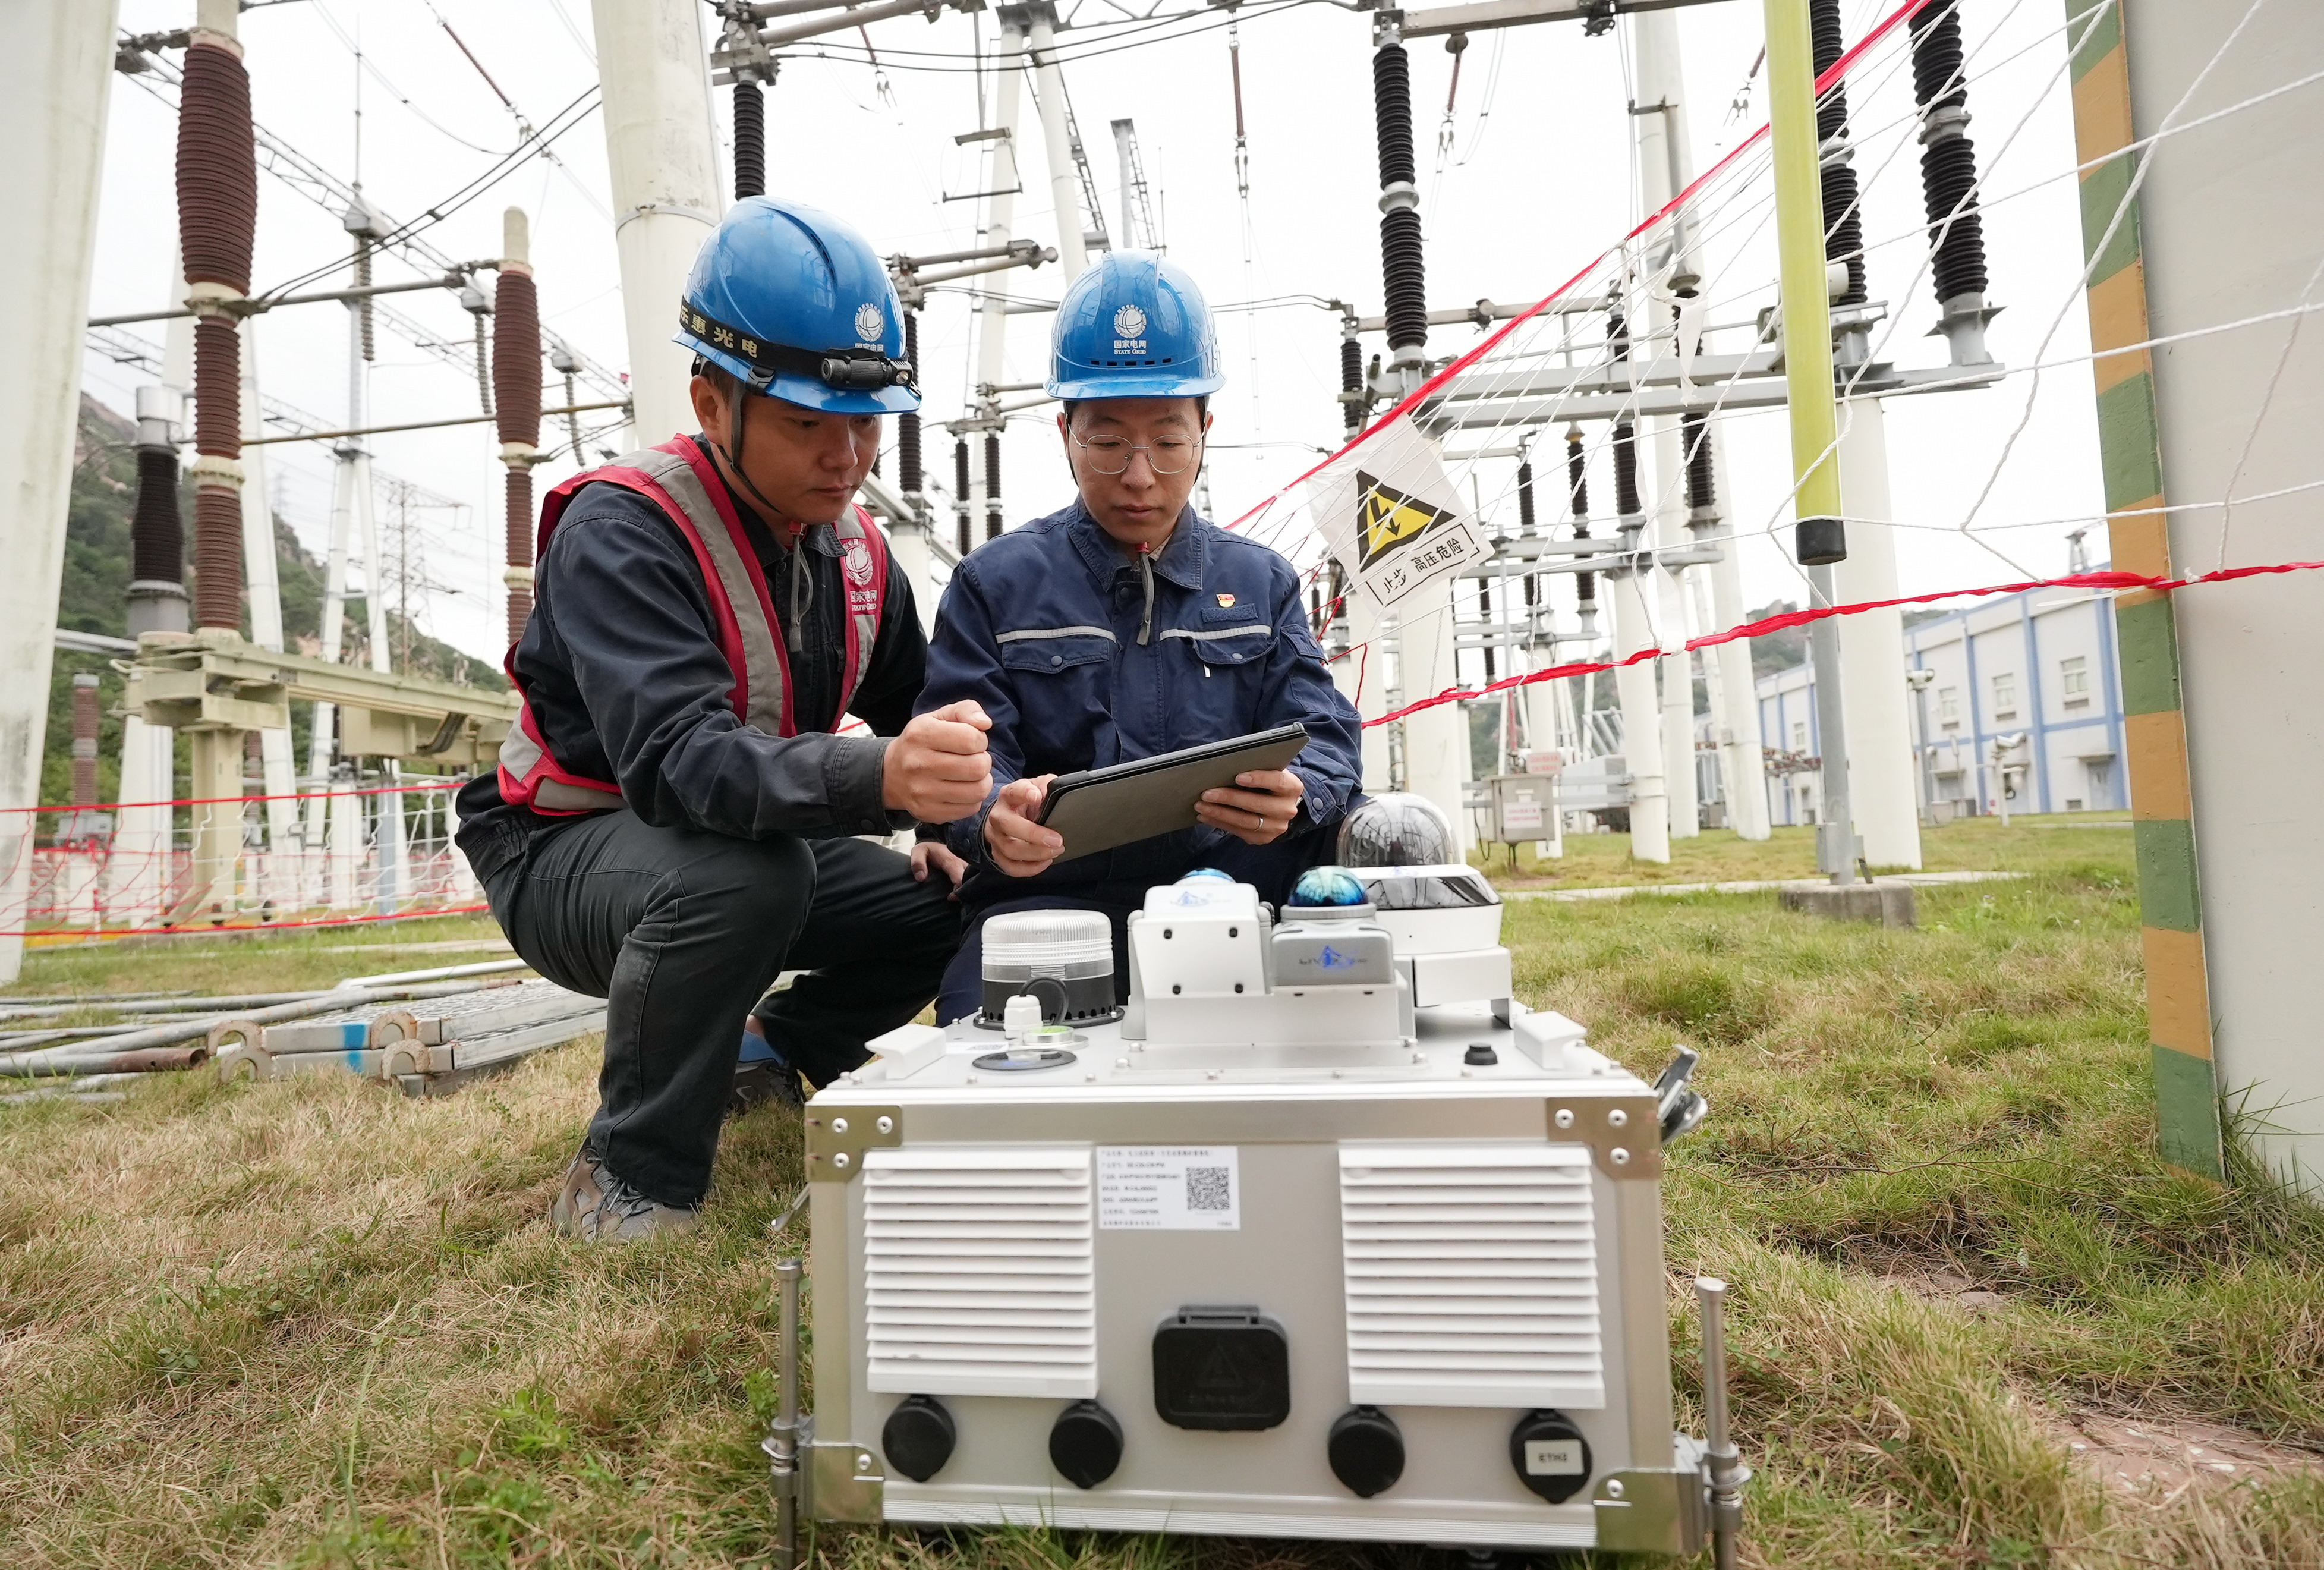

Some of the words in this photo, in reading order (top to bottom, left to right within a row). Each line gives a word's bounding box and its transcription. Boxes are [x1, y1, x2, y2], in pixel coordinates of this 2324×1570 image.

[1114, 339, 1147, 348] 国家电网
[1410, 537, 1465, 573] 高压危险
